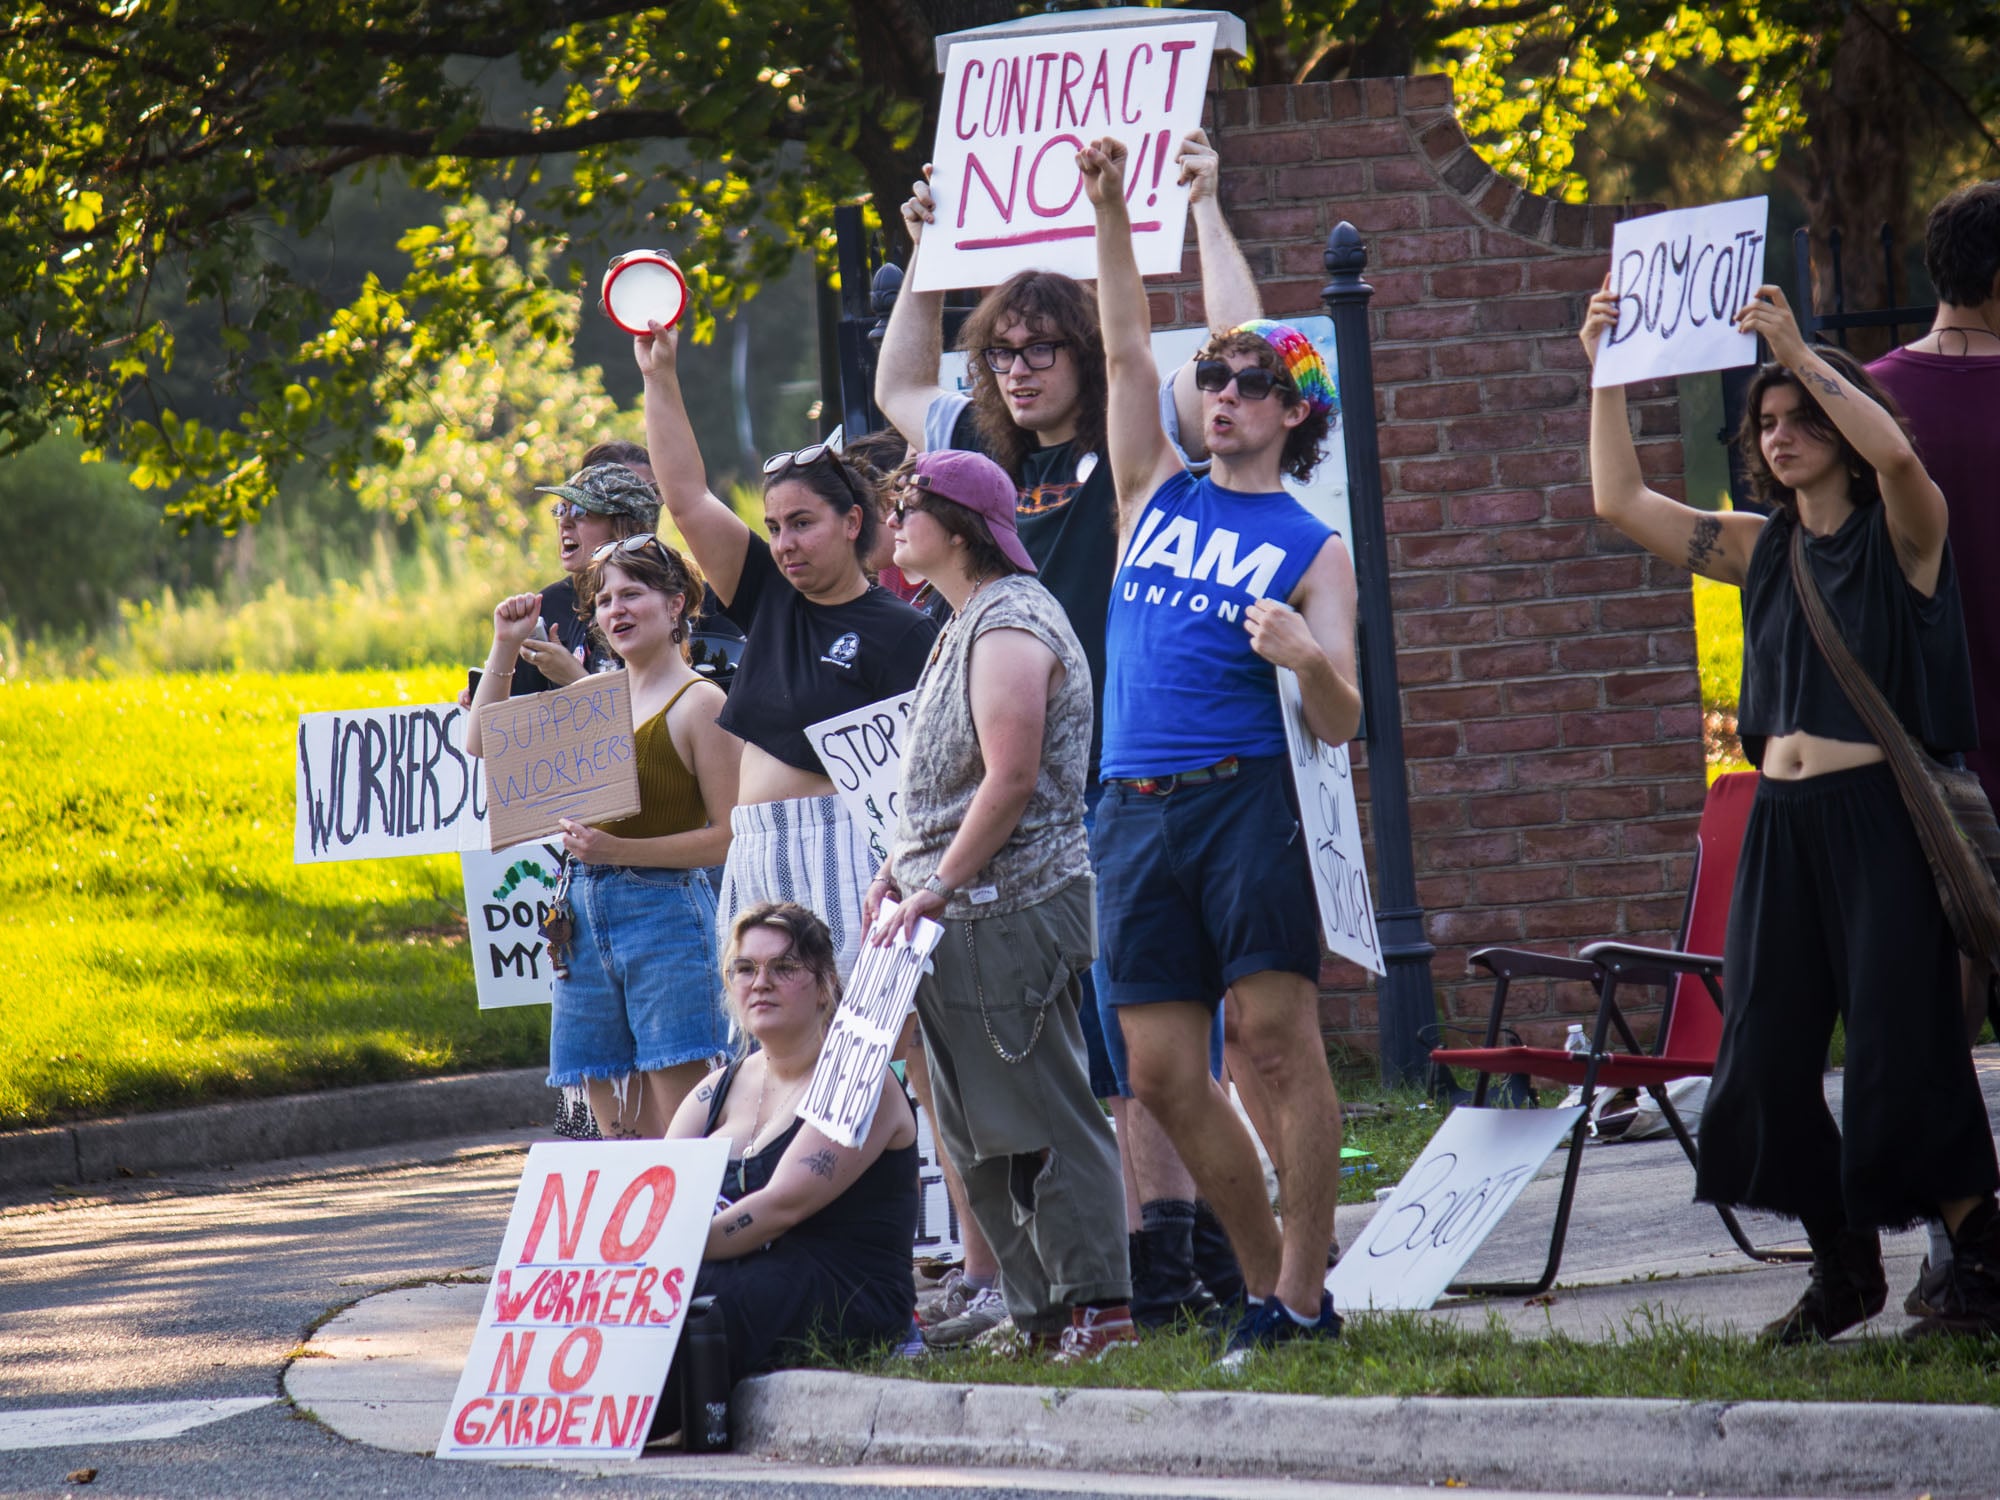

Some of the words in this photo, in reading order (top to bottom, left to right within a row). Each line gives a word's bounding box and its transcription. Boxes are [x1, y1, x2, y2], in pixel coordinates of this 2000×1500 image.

[956, 40, 1196, 140] CONTRACT
[1607, 230, 1763, 347] BOYCOTT
[1125, 508, 1287, 600] IAM
[1123, 580, 1240, 623] UNION
[489, 688, 621, 757] SUPPORT
[821, 713, 900, 791] STOP
[299, 708, 468, 857] WORKERS
[492, 735, 632, 807] WORKERS
[1319, 781, 1342, 837] ON
[1316, 838, 1381, 971] STRIKE!
[489, 942, 543, 980] MY
[842, 926, 925, 1035] SOLIDARITY
[804, 1020, 888, 1133] FOREVER
[519, 1165, 676, 1265] NO
[495, 1266, 685, 1324] WORKERS
[487, 1326, 603, 1394] NO
[453, 1394, 654, 1448] GARDEN!
